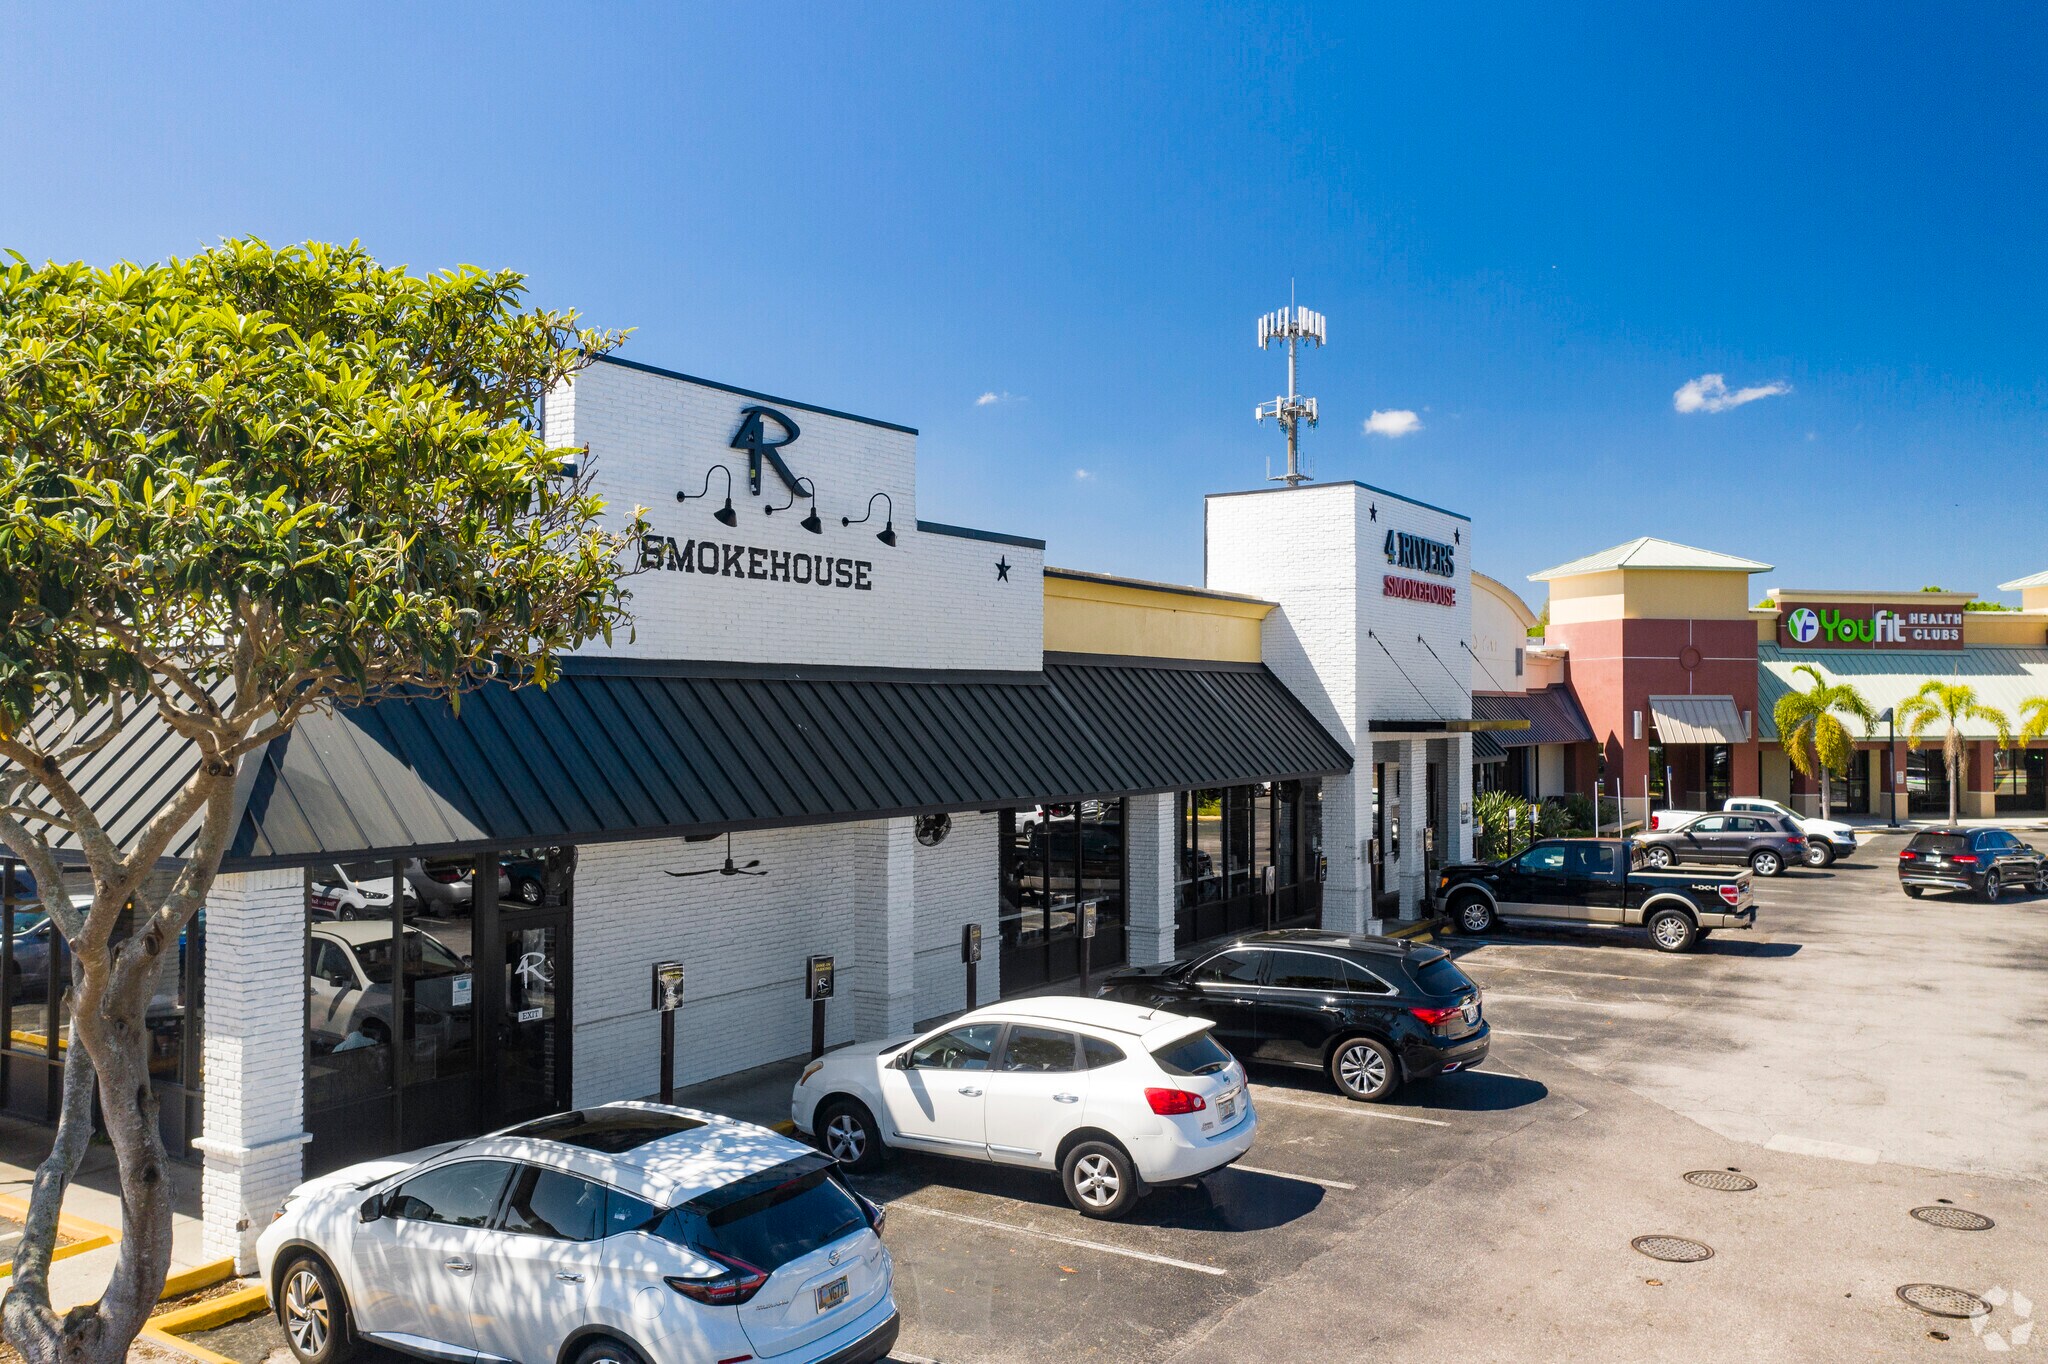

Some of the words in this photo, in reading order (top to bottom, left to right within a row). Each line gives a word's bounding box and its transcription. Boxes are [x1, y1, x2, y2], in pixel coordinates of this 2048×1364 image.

[641, 534, 872, 591] SMOKEHOUSE
[1384, 530, 1396, 564] 4
[1397, 532, 1455, 578] RIVERS
[1383, 575, 1456, 606] SMOKEHOUSE
[1909, 612, 1962, 625] HEALTH
[1913, 628, 1960, 641] CLUBS
[522, 1010, 539, 1020] EXIT
